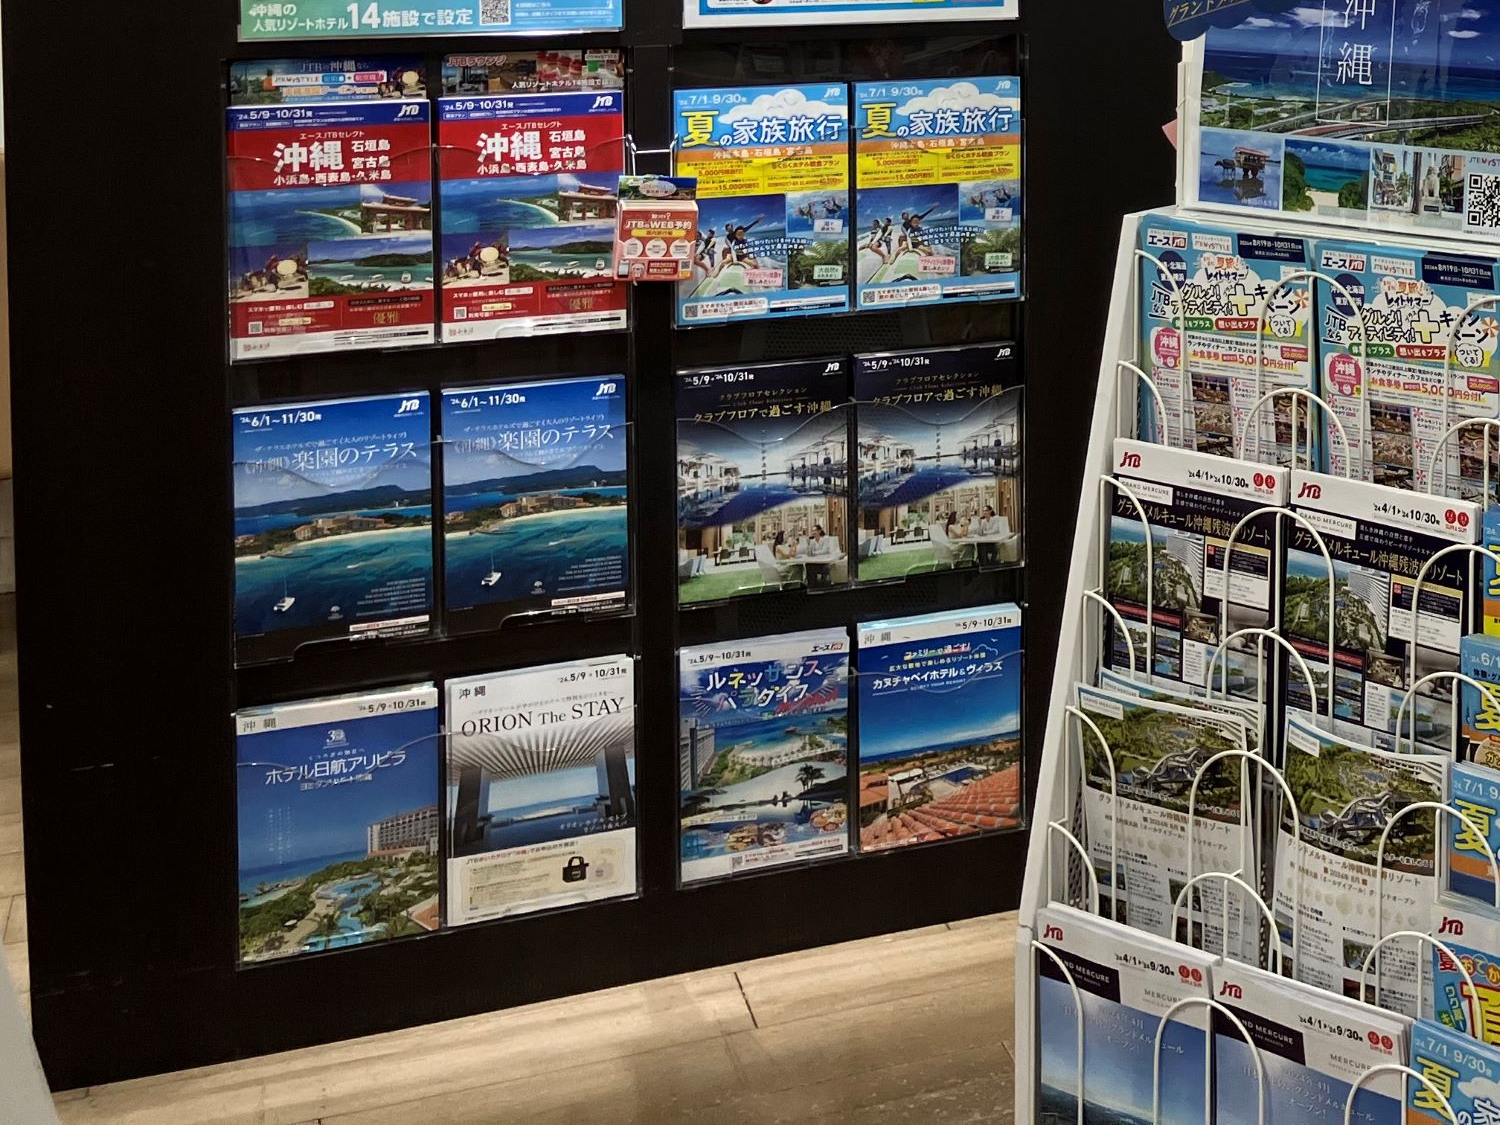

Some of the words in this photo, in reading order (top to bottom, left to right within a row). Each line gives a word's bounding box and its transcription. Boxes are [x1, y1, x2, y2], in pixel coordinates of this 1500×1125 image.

[592, 95, 614, 109] JTB
[399, 104, 420, 117] JTB
[681, 110, 843, 148] 夏の家族旅行
[861, 103, 1013, 140] 夏の家族旅行
[549, 129, 586, 143] 石垣島
[351, 138, 391, 153] 石垣島
[475, 130, 543, 163] 沖縄
[549, 145, 586, 159] 宮古島
[273, 140, 344, 173] 沖縄
[351, 154, 391, 169] 宮古島
[596, 382, 617, 396] JTB
[398, 399, 420, 413] JTB
[1120, 451, 1142, 468] JTB
[1298, 481, 1322, 500] JTB
[863, 631, 892, 645] 沖縄
[458, 684, 486, 699] 沖縄
[242, 717, 277, 732] 沖縄
[461, 711, 533, 738] ORION
[538, 710, 567, 727] The
[571, 697, 625, 720] STAY
[264, 750, 407, 785] ホテル日航アリビラ
[1043, 924, 1064, 941] JTB
[1438, 917, 1464, 936] JTB
[1219, 981, 1243, 999] JTB
